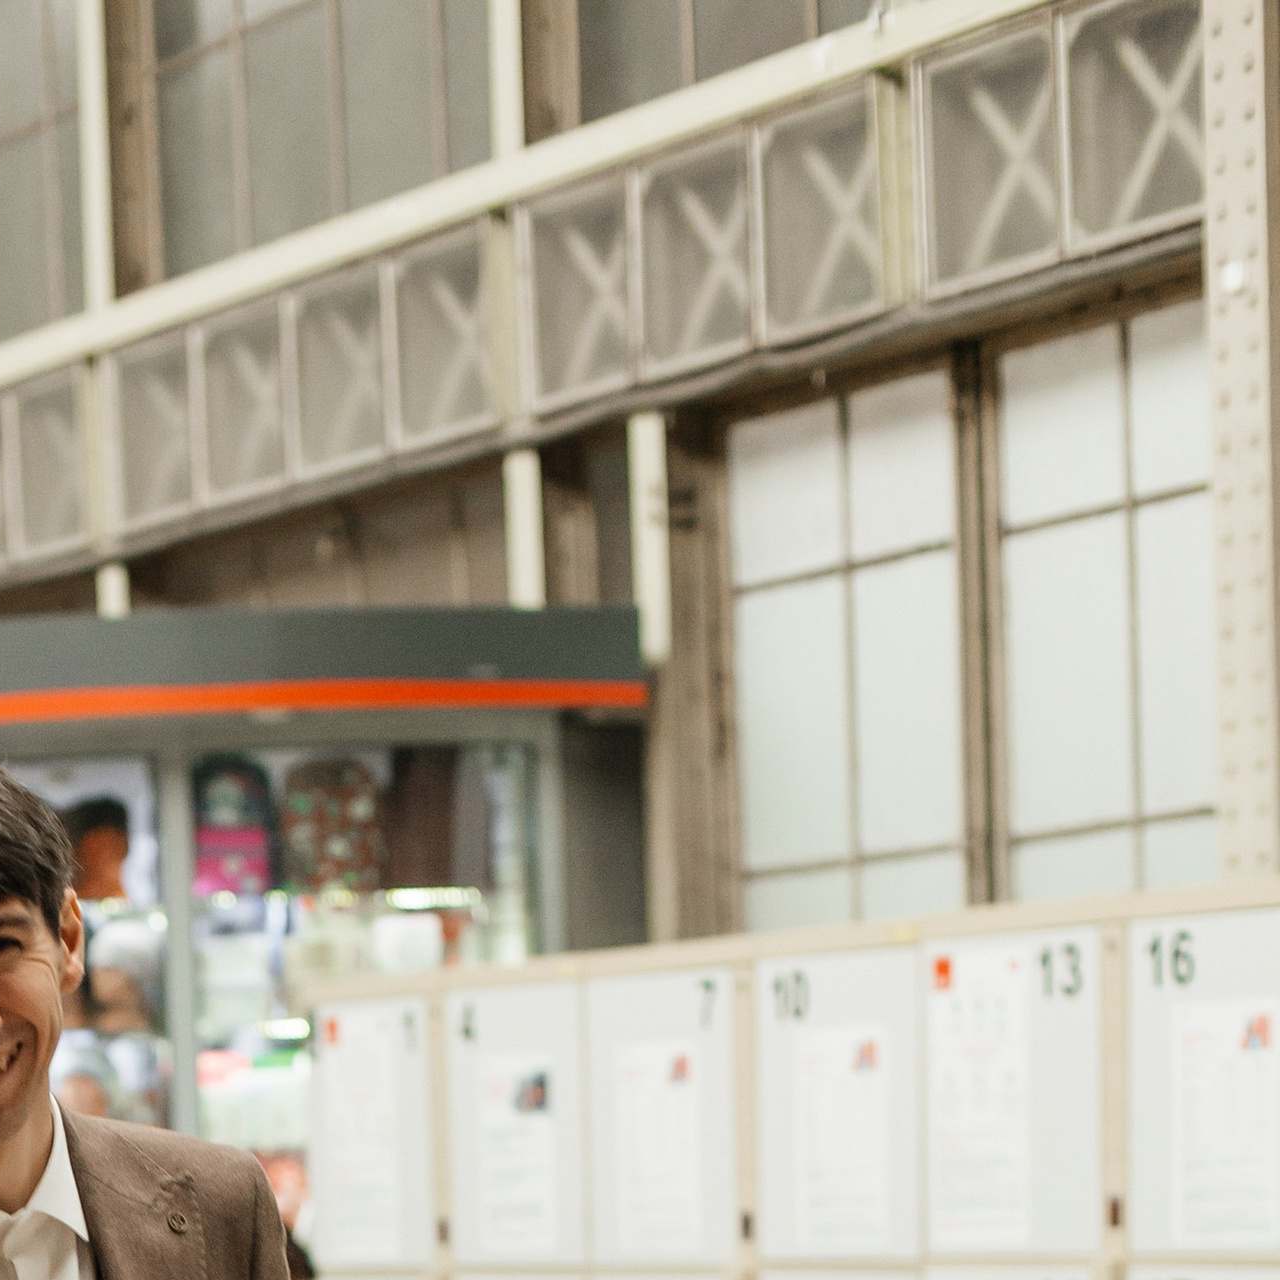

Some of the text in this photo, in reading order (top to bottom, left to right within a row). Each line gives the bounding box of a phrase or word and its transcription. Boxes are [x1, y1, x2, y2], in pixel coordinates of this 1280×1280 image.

[1039, 943, 1083, 998] 13
[1148, 931, 1194, 986] 16
[698, 979, 718, 1028] 7
[771, 970, 809, 1020] 10
[459, 1003, 477, 1042] 4
